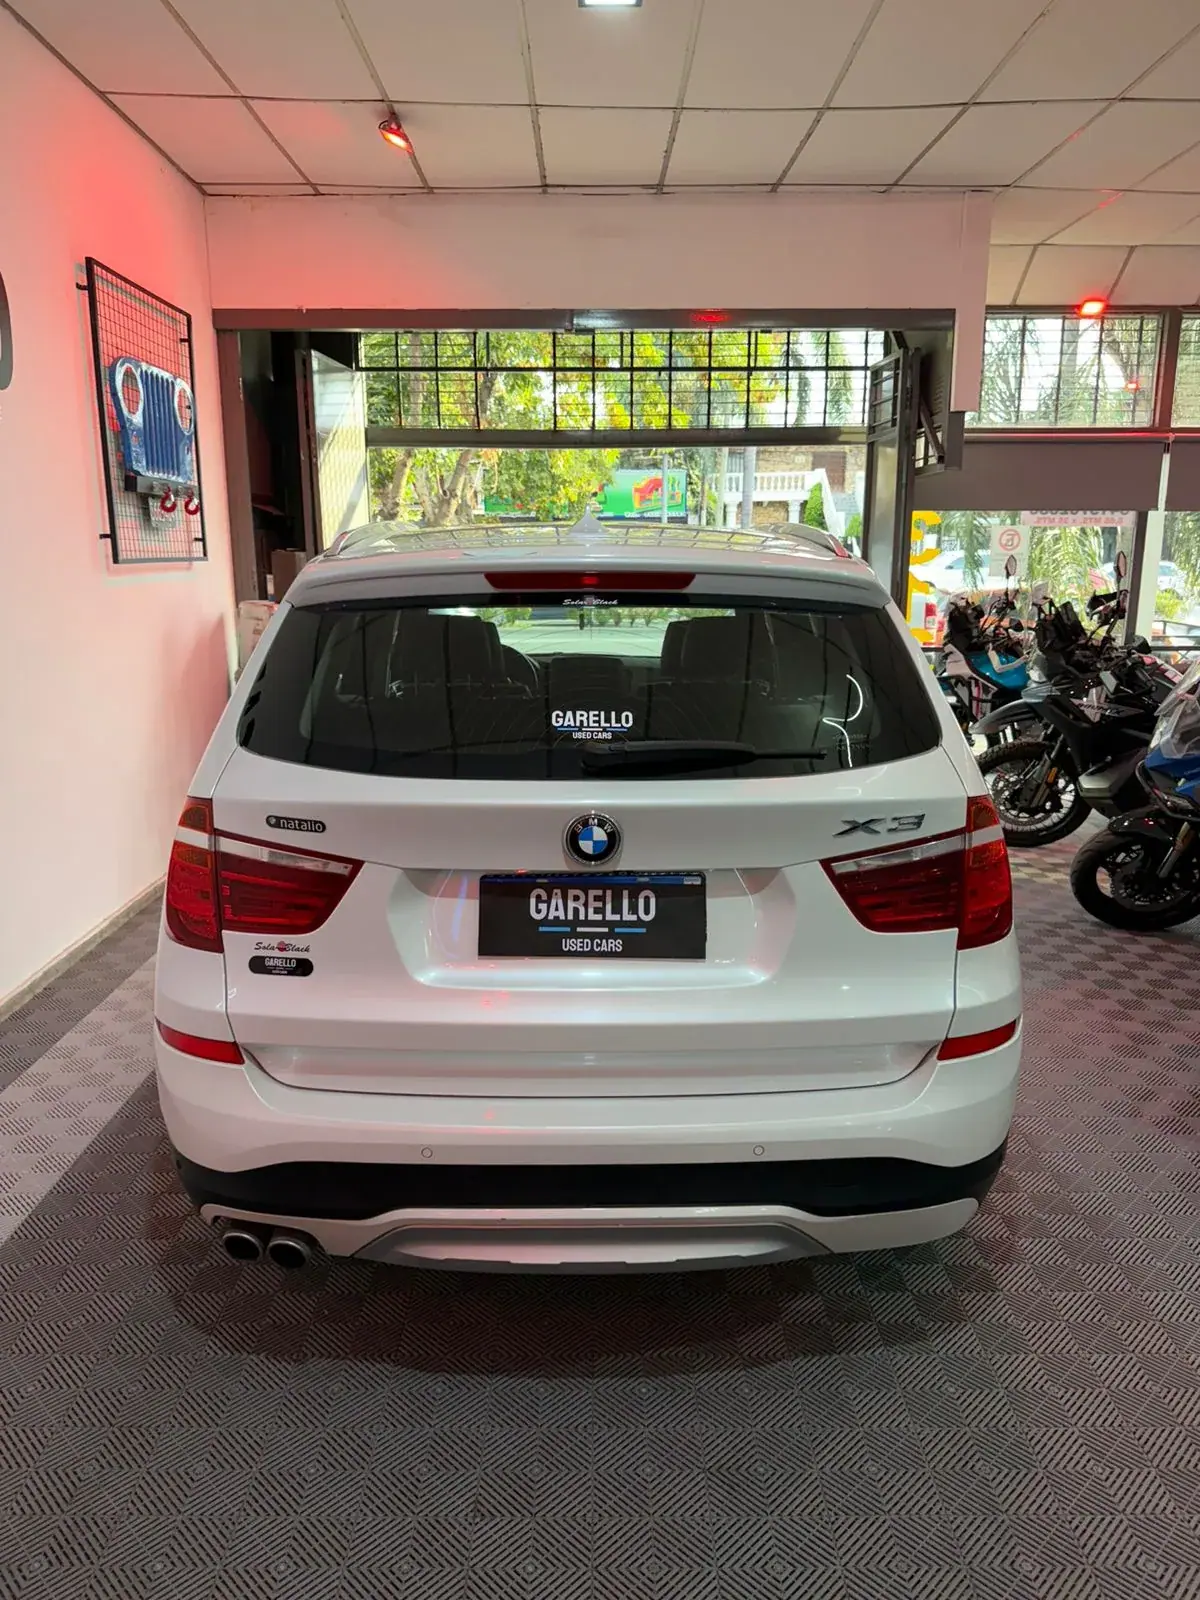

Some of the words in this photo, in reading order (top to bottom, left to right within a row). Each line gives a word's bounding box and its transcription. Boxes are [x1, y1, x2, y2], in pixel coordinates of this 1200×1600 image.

[551, 710, 634, 728] GARELLO
[572, 732, 592, 740] USED
[592, 732, 613, 740] CARS
[280, 817, 324, 832] natalio
[574, 818, 613, 834] BMW
[832, 813, 926, 838] X3
[529, 888, 657, 922] GARELLO
[562, 938, 592, 952] USED
[593, 938, 623, 953] CARS
[264, 957, 297, 968] GARELLO
